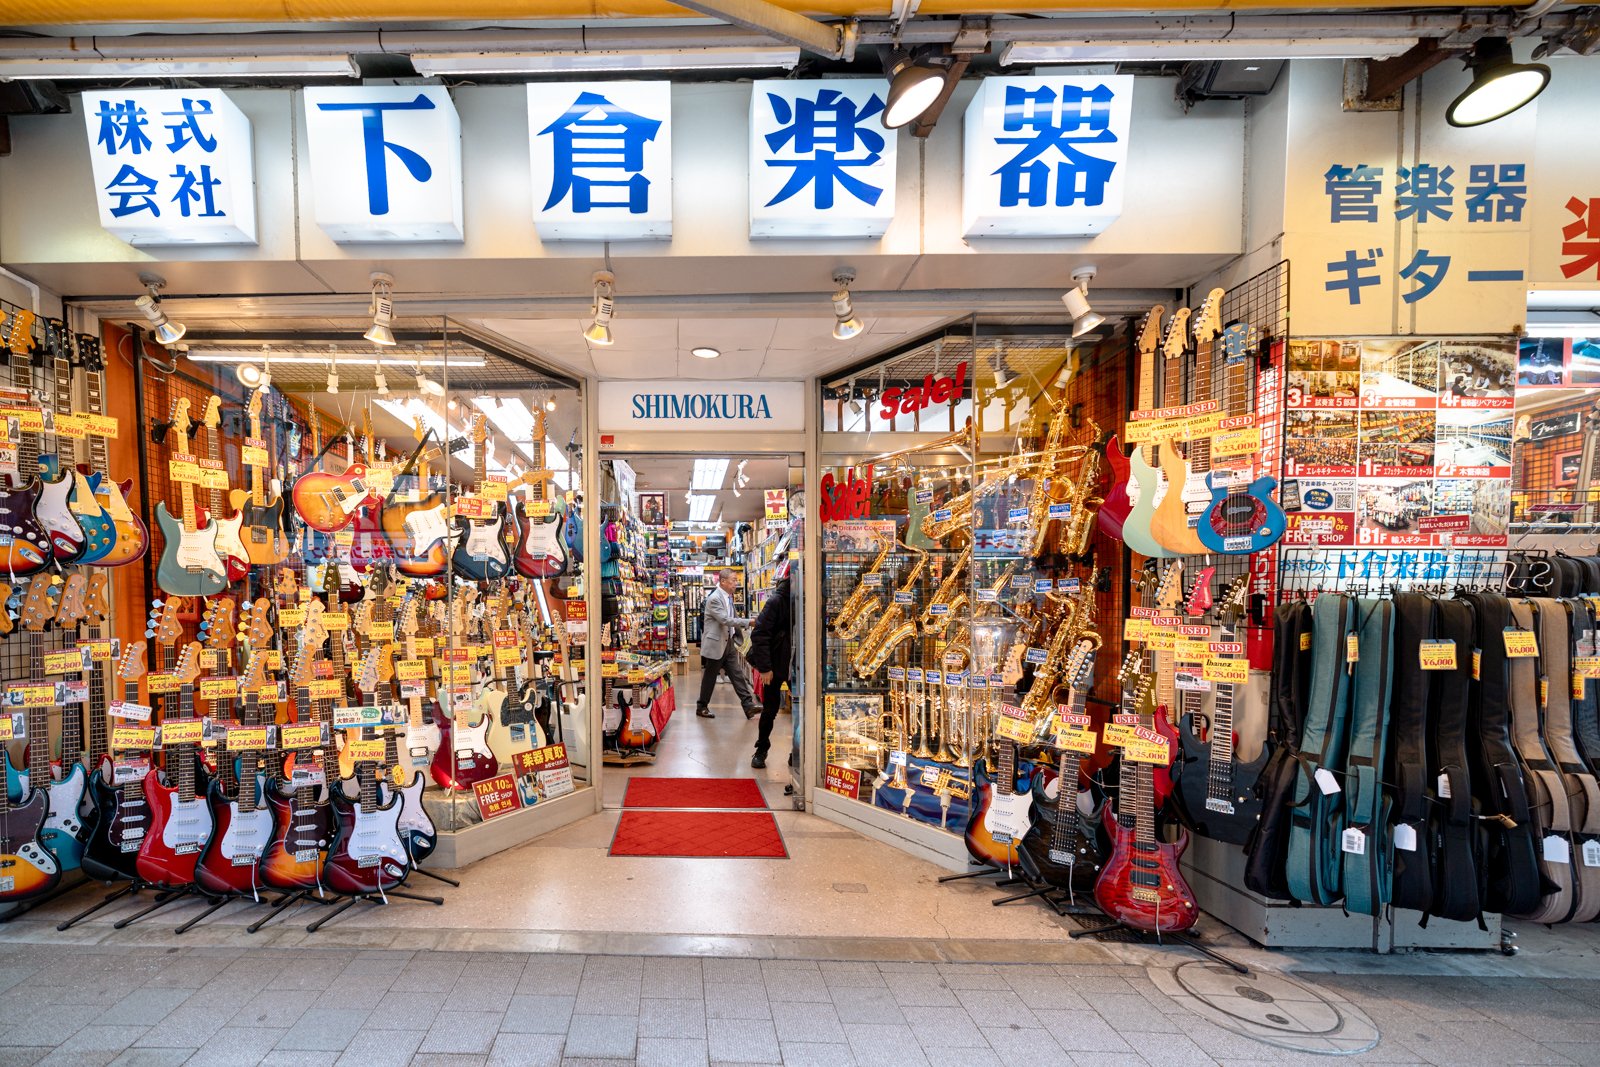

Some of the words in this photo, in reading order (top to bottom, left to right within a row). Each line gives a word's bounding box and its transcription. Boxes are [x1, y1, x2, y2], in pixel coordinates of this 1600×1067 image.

[94, 99, 218, 155] 株式
[105, 164, 225, 218] 会社
[1324, 164, 1527, 223] 管楽器
[1325, 247, 1524, 305] ギター
[880, 361, 968, 420] Sale!
[1287, 388, 1312, 406] 3F
[1364, 389, 1383, 407] 3F
[1441, 390, 1460, 407] 4F
[632, 394, 773, 419] SHIMOKURA
[1187, 401, 1217, 415] USED
[1131, 411, 1154, 420] USE
[1158, 408, 1185, 418] USED
[1219, 415, 1253, 429] USED
[84, 423, 116, 435] 29,800
[174, 453, 195, 462] USED
[202, 460, 221, 468] USED
[1285, 457, 1305, 476] 1F
[1363, 458, 1382, 476] 1F
[1438, 459, 1457, 476] 2F
[820, 463, 874, 523] Sale!
[1335, 524, 1349, 532] OFF
[1321, 534, 1344, 542] SHOP
[1359, 527, 1387, 544] B1F
[1132, 608, 1159, 617] USED
[1153, 616, 1181, 625] USED
[1180, 626, 1209, 635] USED
[1210, 643, 1241, 653] USED
[1508, 646, 1536, 654] ¥6,000
[1423, 658, 1454, 667] ¥6,000
[1003, 705, 1026, 718] USED
[1062, 715, 1090, 725] USED
[1115, 715, 1140, 724] USED
[163, 731, 202, 741] ¥24,800
[283, 735, 320, 746] ¥24,800
[1136, 726, 1165, 745] USED
[113, 737, 152, 747] ¥29,800
[228, 739, 266, 747] ¥24,800
[349, 750, 384, 758] ¥18,800
[522, 745, 565, 768] 楽器買取
[827, 765, 840, 777] TAX
[826, 775, 842, 787] FREE
[476, 782, 494, 795] TAX
[480, 791, 501, 806] FREE
[500, 791, 513, 800] SHOP
